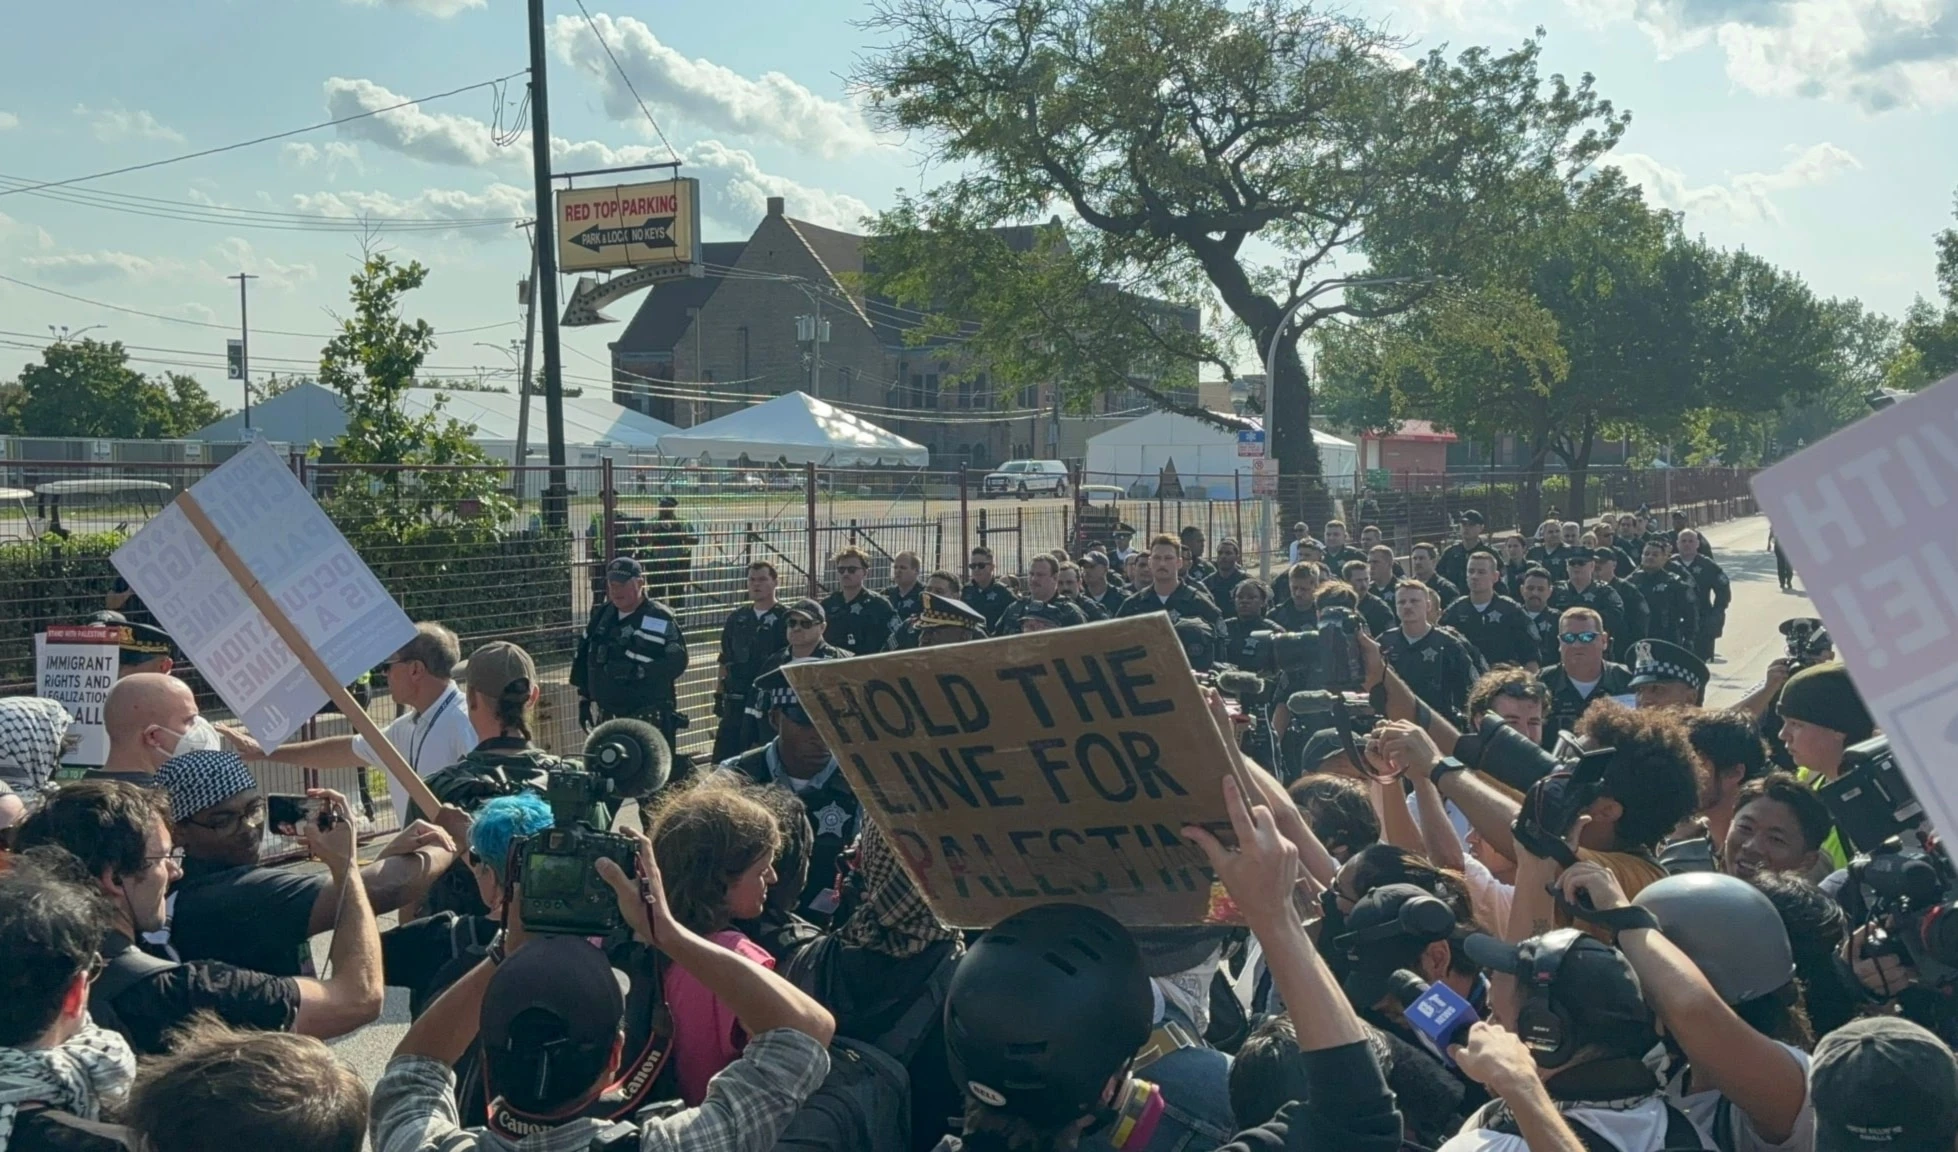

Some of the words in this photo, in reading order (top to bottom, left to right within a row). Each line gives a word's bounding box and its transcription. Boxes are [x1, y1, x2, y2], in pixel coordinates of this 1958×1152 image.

[565, 204, 590, 221] RED
[594, 200, 618, 219] TOP
[622, 195, 677, 216] PARKING
[582, 233, 600, 245] PARK
[602, 234, 607, 243] &
[607, 231, 628, 243] LOCK
[632, 229, 643, 241] NO
[645, 227, 665, 240] KEYS
[46, 656, 112, 671] IMMIGRANT
[45, 675, 80, 688] RIGHTS
[85, 676, 111, 689] AND
[813, 674, 990, 744] HOLD
[997, 645, 1175, 728] THE
[74, 707, 102, 724] ALL
[850, 745, 1024, 815] LINE
[1027, 731, 1189, 804] FOR
[1435, 1006, 1456, 1025] NEWS
[619, 1050, 661, 1100] Canon
[973, 1085, 1000, 1102] BELL
